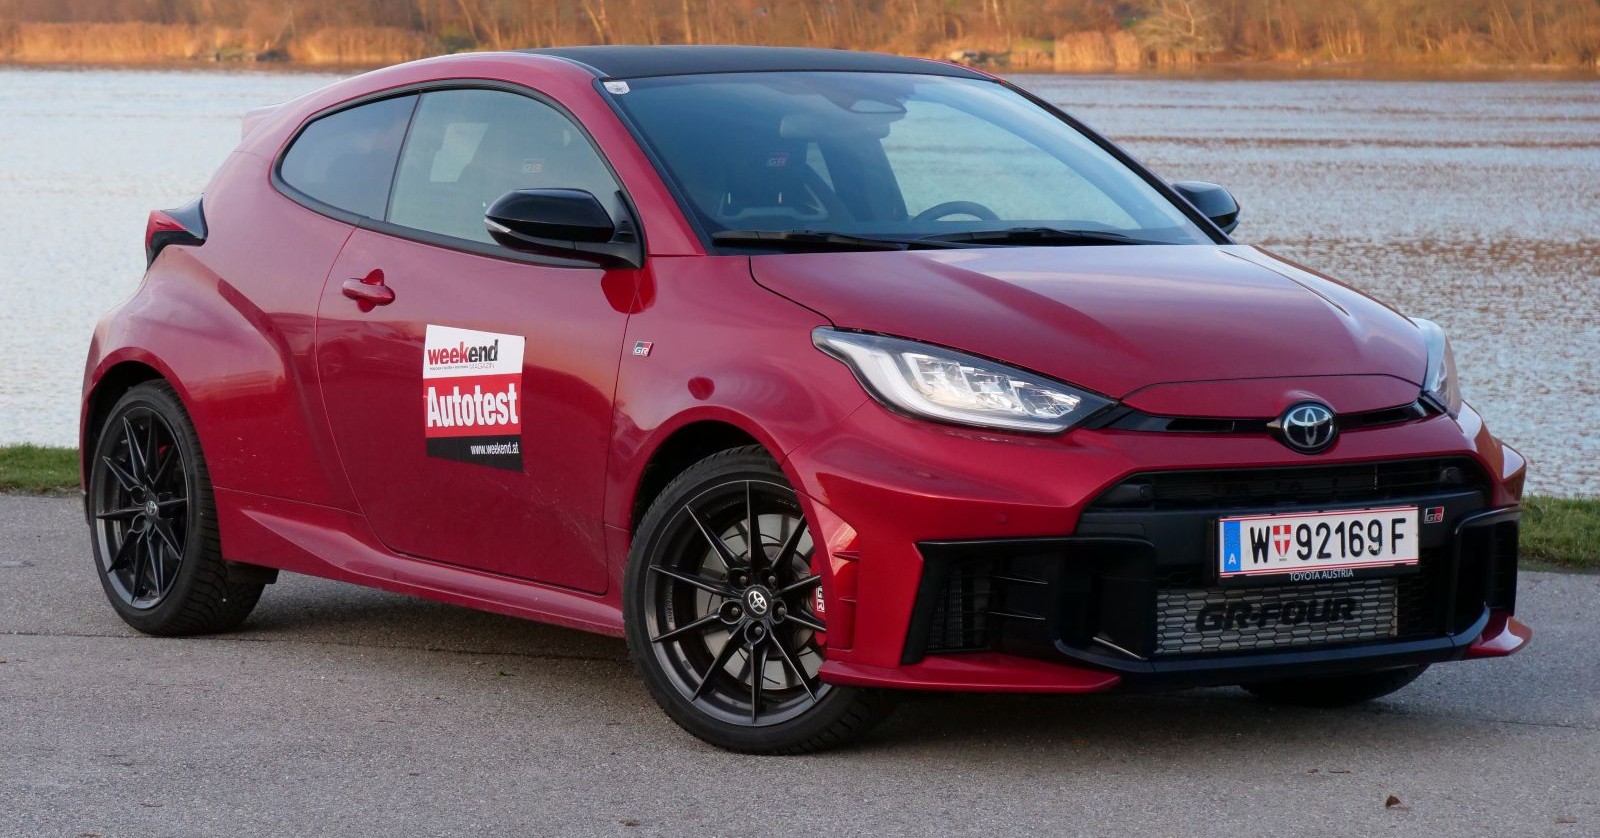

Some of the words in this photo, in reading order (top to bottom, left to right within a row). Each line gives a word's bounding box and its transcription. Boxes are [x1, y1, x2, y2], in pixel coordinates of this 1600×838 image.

[427, 339, 499, 365] weekend
[634, 346, 650, 356] GR
[427, 383, 519, 428] Autotest
[470, 442, 519, 455] www.weekend.at
[1250, 525, 1271, 564] W
[1295, 518, 1383, 561] 92169
[1391, 517, 1407, 554] F
[1228, 553, 1237, 565] A
[1289, 571, 1321, 582] TOYOTA
[1321, 569, 1354, 580] AUSTRIA
